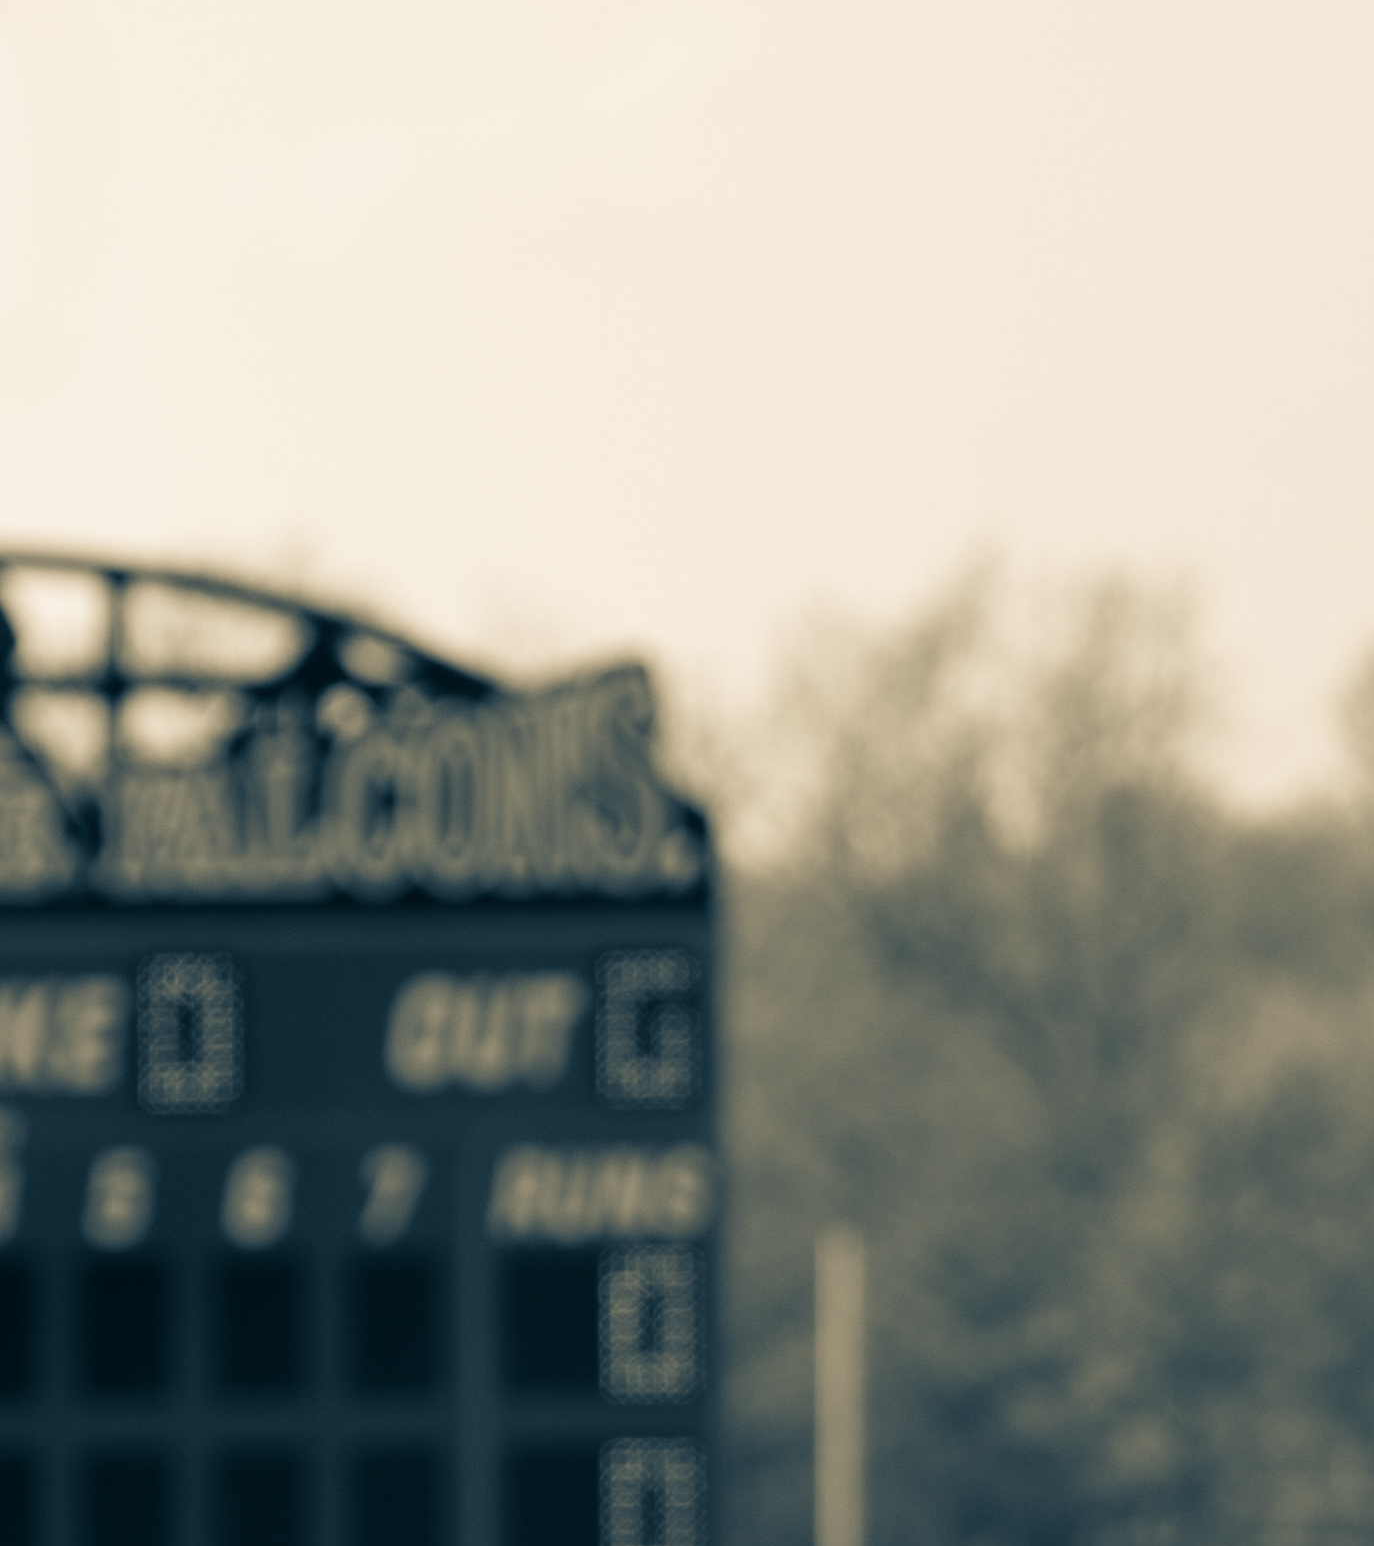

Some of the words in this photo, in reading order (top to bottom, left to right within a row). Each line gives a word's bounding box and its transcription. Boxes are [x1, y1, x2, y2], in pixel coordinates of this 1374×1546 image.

[385, 970, 588, 1092] OUT
[360, 1145, 427, 1247] 7
[489, 1142, 710, 1244] RUNS
